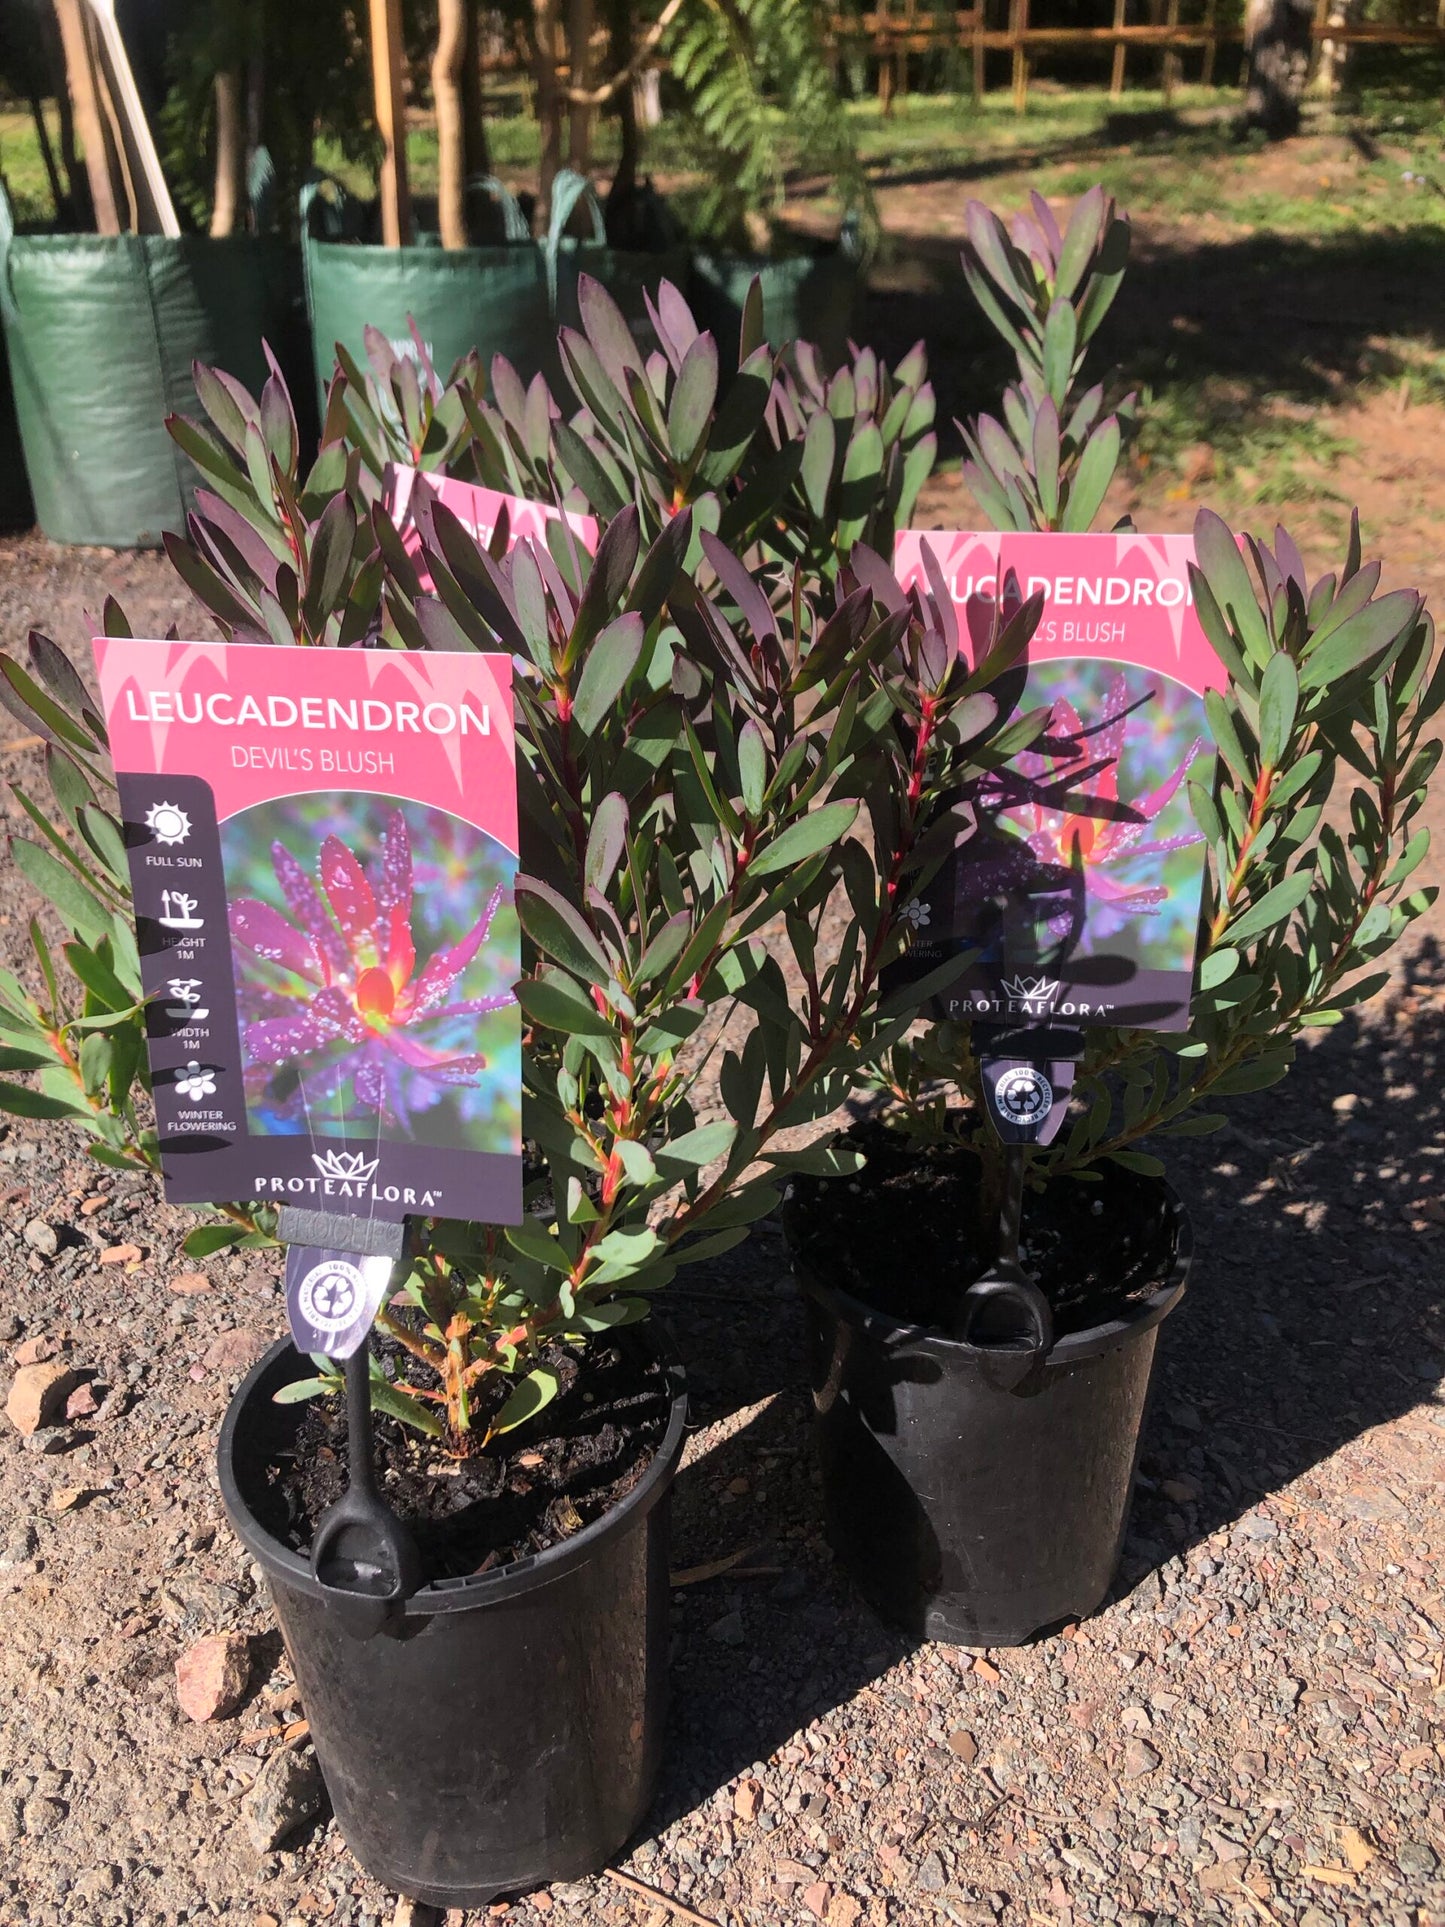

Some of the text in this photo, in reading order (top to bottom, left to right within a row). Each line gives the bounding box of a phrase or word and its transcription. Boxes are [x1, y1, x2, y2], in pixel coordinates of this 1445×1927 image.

[1062, 621, 1126, 643] BLUSH
[126, 690, 491, 737] LEUCADENDRON
[231, 745, 395, 774] DEVIL'S BLUSH
[145, 855, 203, 868] FULL SUN
[162, 936, 206, 948] HEIGHT
[177, 950, 195, 960] 1M
[170, 1027, 210, 1038] WIDTH
[183, 1040, 200, 1049] 1M
[177, 1110, 224, 1120] WINTER
[167, 1121, 237, 1132] FLOWERING
